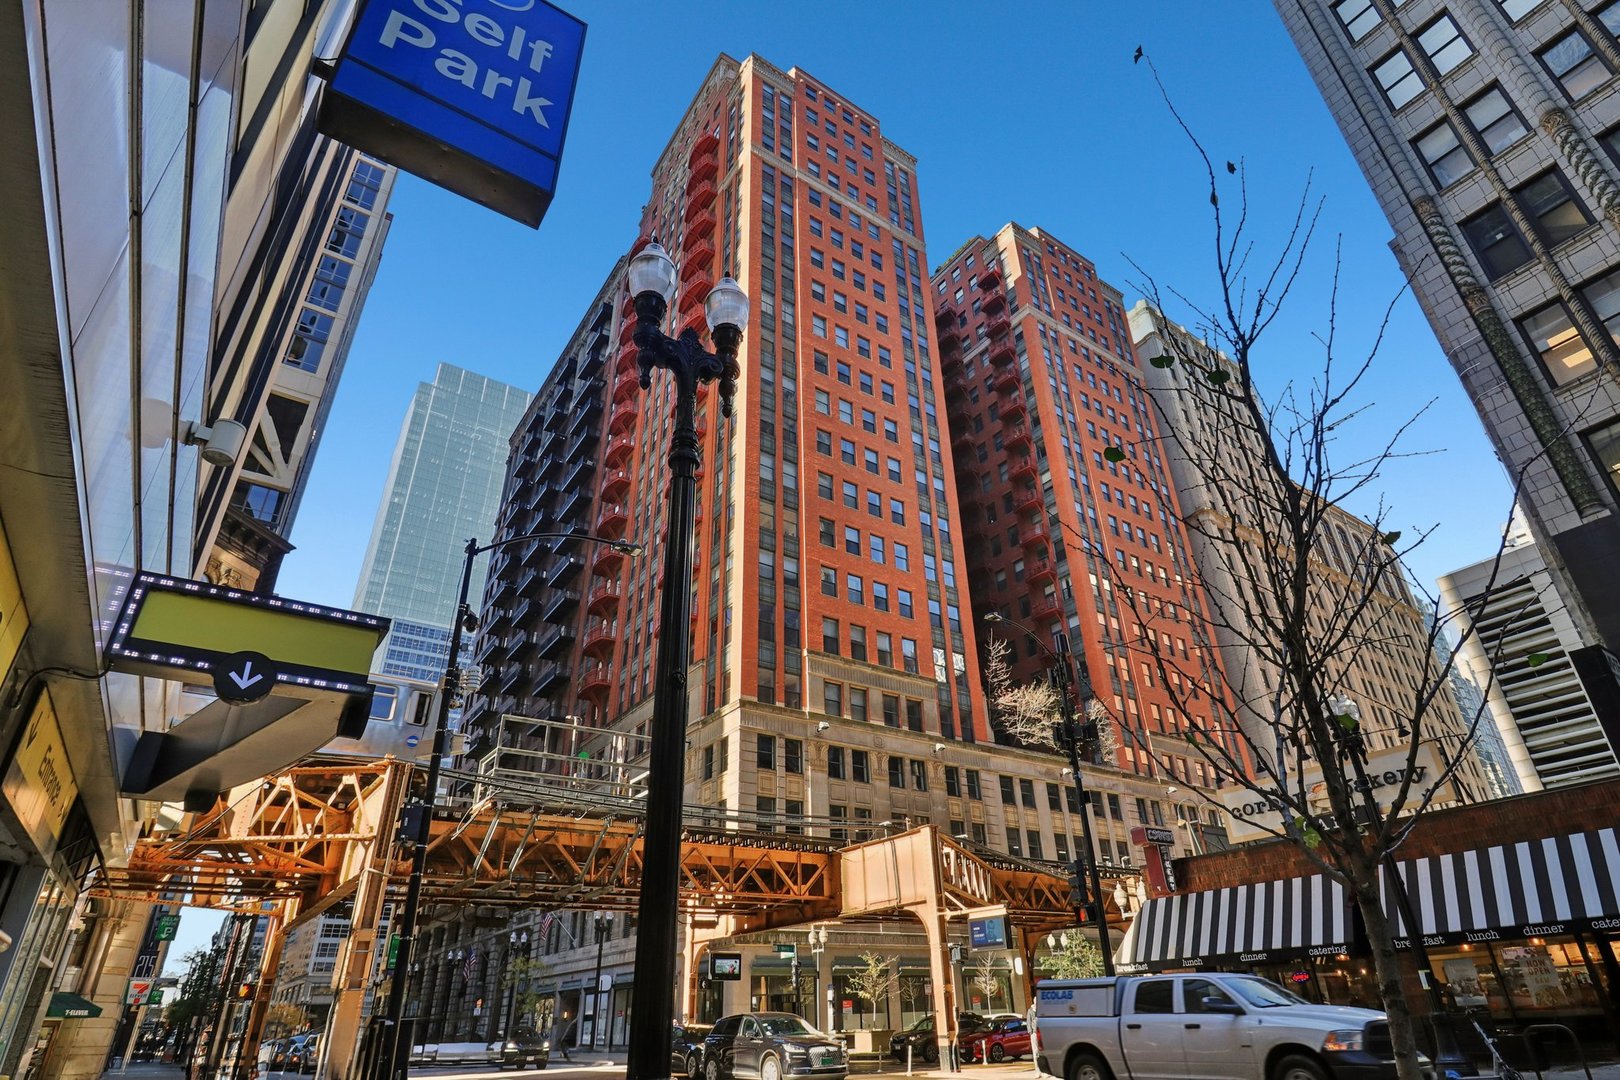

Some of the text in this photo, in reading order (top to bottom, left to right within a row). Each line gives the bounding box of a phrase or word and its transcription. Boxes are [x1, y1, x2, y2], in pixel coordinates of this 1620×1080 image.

[412, 0, 553, 73] Self
[379, 9, 554, 129] Park
[1394, 918, 1620, 949] brefast lunch dinner cate
[134, 955, 157, 978] 215
[1182, 958, 1203, 967] lunch
[1240, 952, 1267, 962] dinner
[1309, 945, 1348, 956] catering
[1526, 958, 1546, 968] NOW
[1528, 967, 1551, 976] OPEN
[1041, 991, 1073, 1000] ECOLAB
